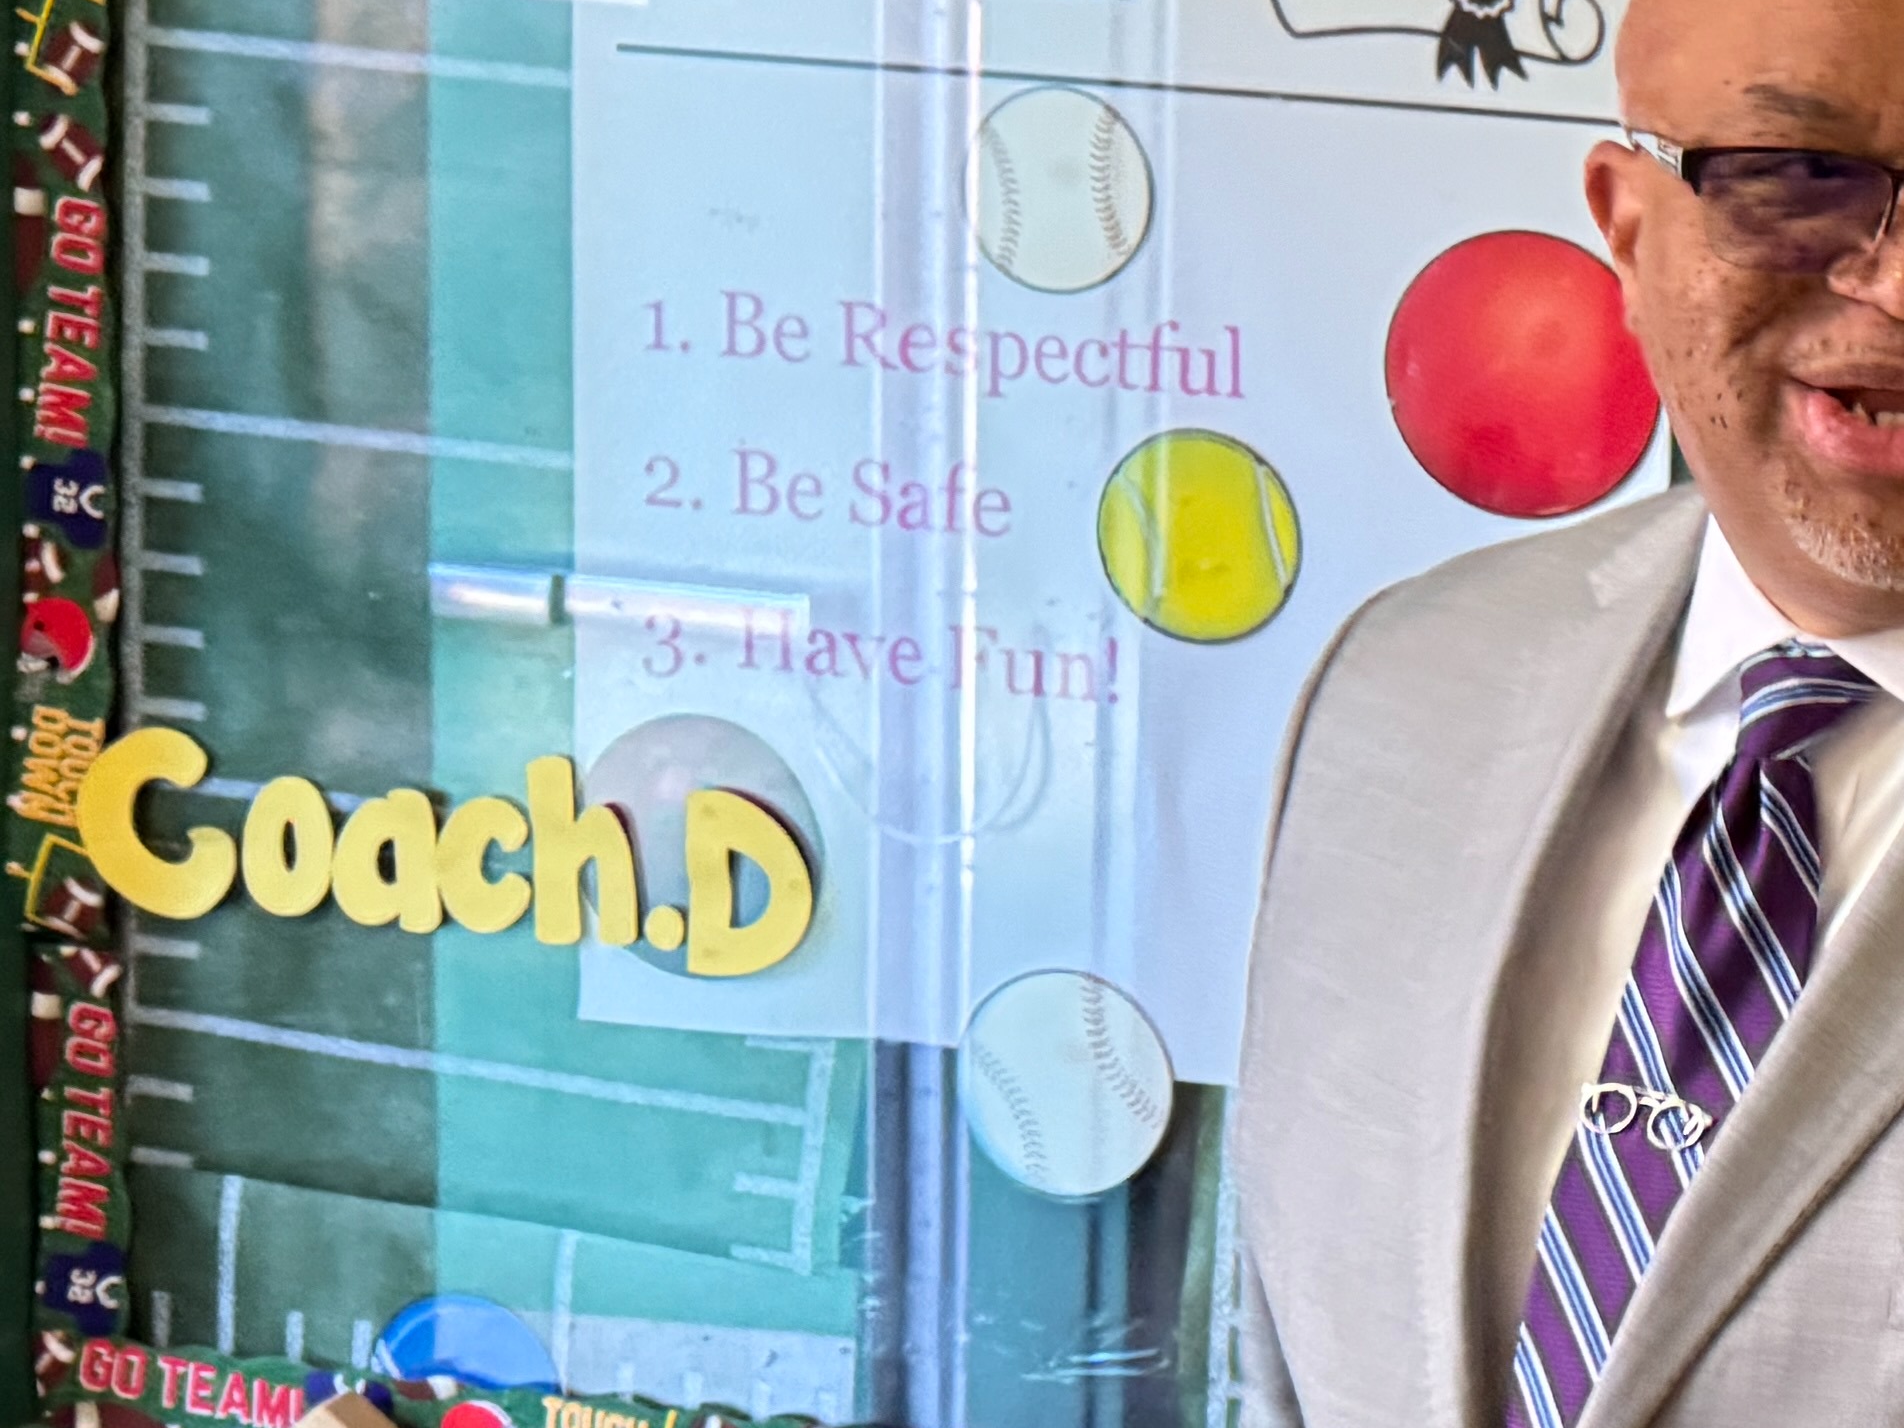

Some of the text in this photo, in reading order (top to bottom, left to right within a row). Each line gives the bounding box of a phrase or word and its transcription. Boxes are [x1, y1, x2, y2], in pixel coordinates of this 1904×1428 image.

[34, 196, 107, 449] GO TEAM!
[643, 289, 1248, 399] 1. Be Respectful
[52, 478, 78, 515] 32
[643, 448, 1012, 538] 2. Be Safe
[642, 609, 1122, 704] 3. Have Fun!
[56, 1001, 116, 1241] GO TEAM!
[79, 1338, 148, 1401] GO
